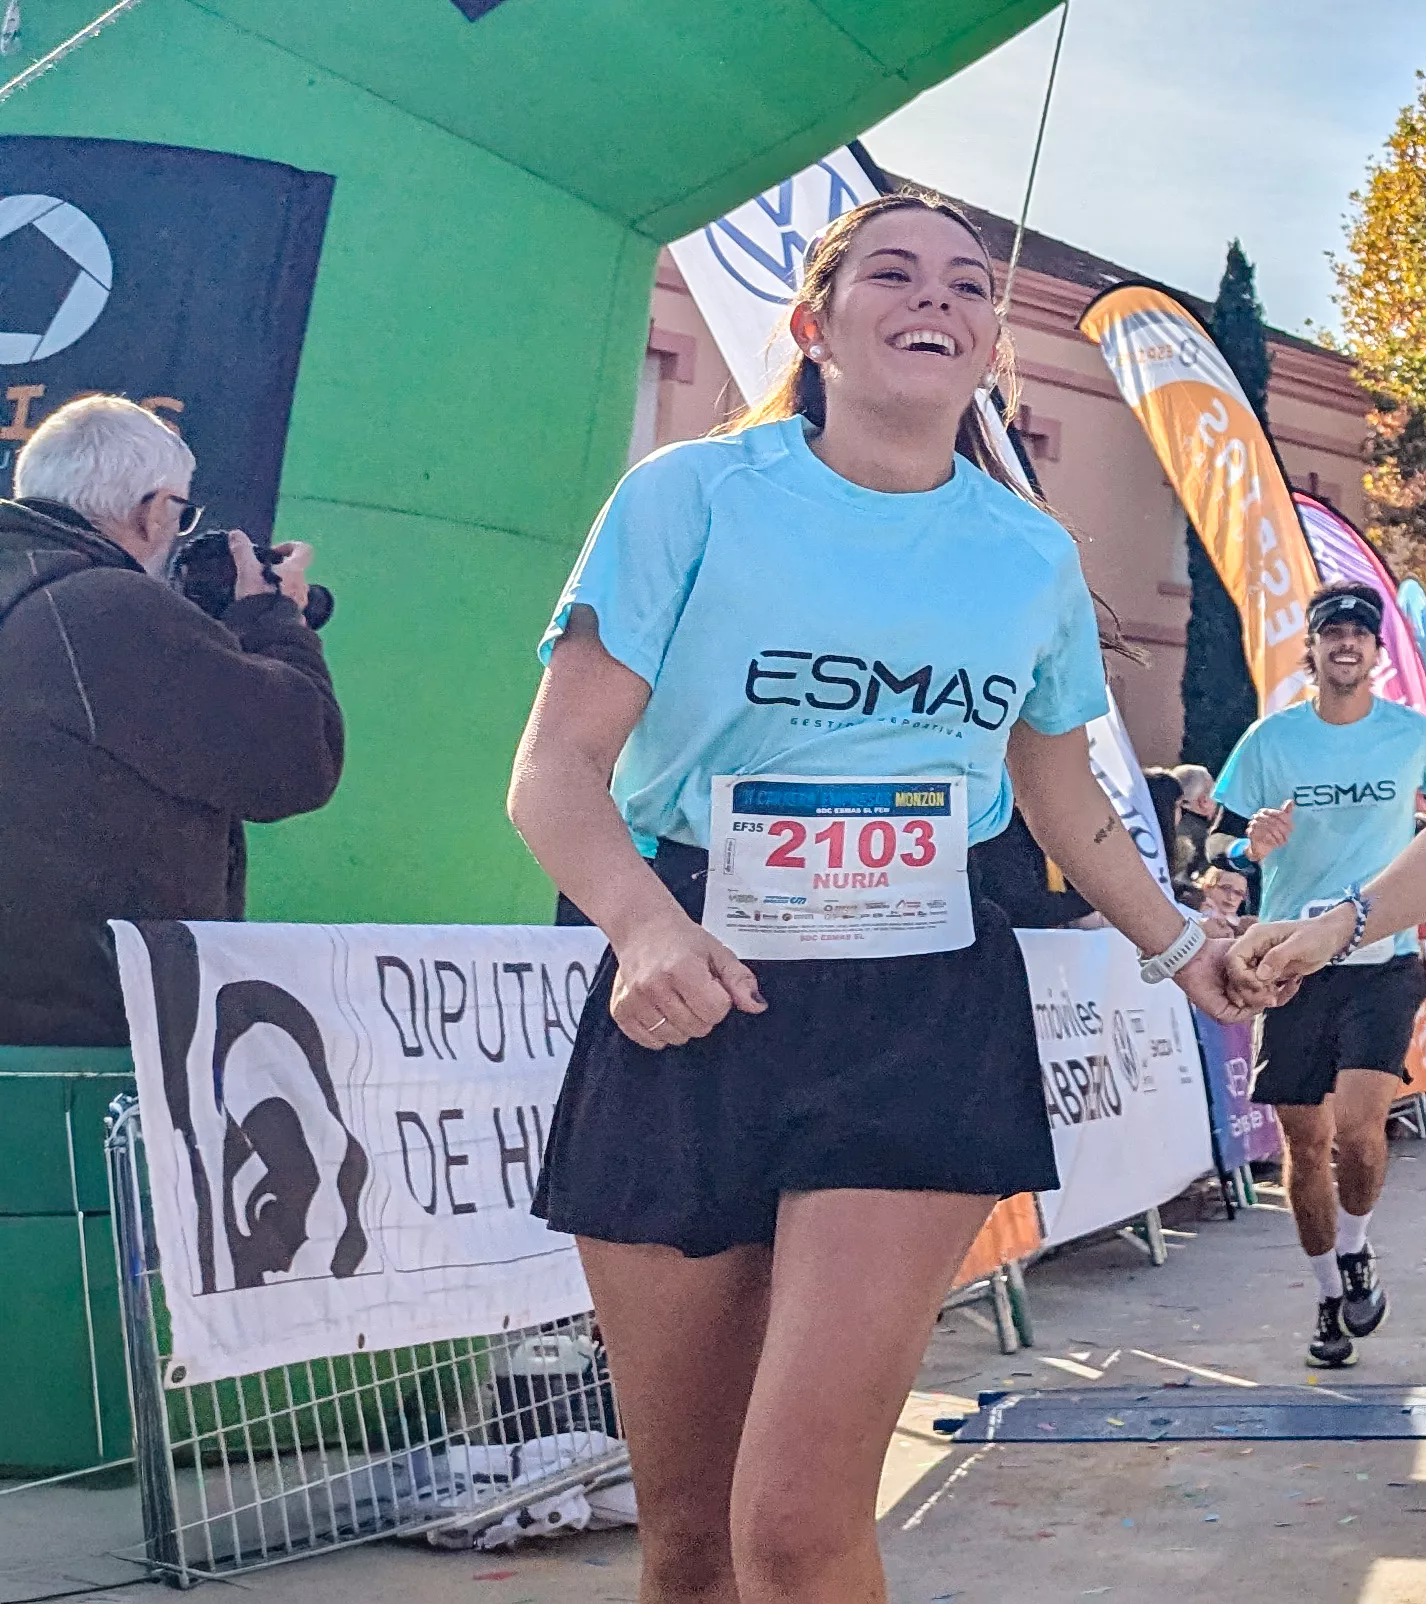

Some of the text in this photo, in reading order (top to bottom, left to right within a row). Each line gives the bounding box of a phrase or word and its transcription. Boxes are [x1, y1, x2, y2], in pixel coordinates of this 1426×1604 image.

[745, 650, 1017, 731] ESMAS
[895, 787, 945, 807] MONZÓN
[1293, 780, 1396, 807] ESMAS
[732, 821, 764, 833] EF35
[765, 820, 937, 869] 2103
[812, 872, 890, 889] NURIA
[375, 955, 598, 1062] DIPUTAC
[396, 1107, 478, 1216] DE
